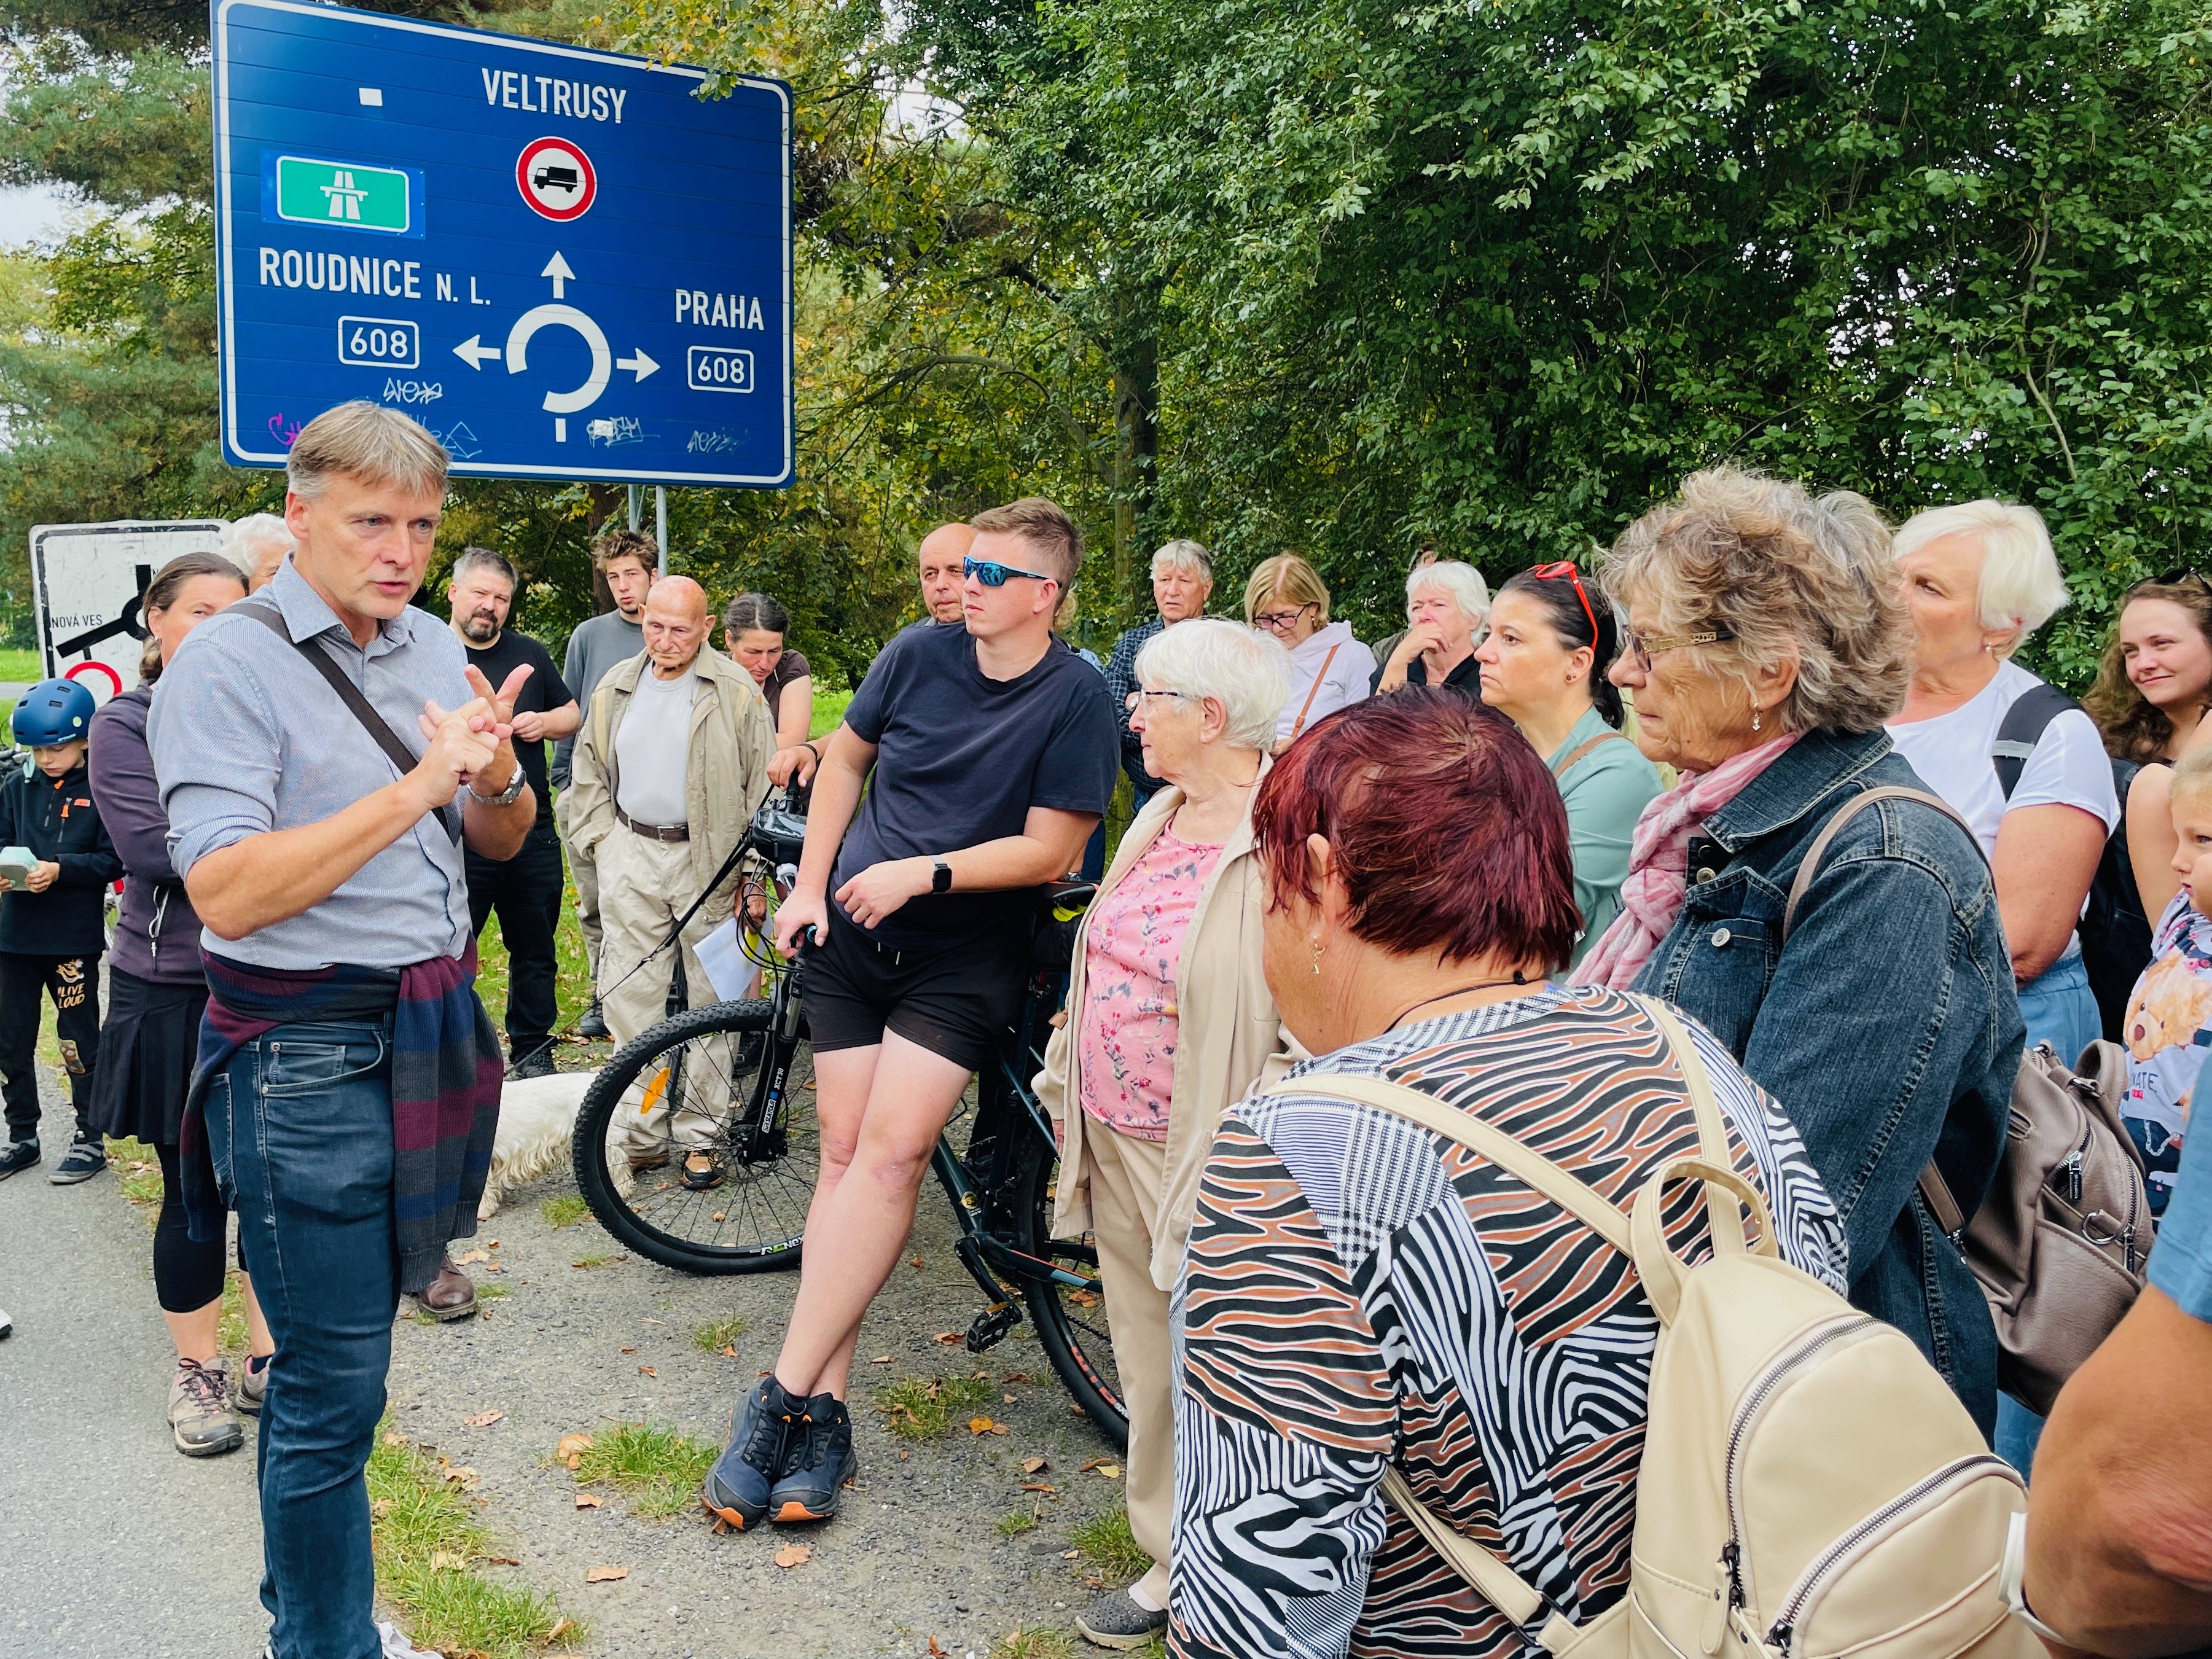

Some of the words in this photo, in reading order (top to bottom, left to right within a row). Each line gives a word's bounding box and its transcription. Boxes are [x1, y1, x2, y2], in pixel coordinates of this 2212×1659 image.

[481, 67, 627, 124] VELTRUSY
[259, 246, 421, 299] ROUDNICE
[436, 273, 459, 303] N.
[470, 276, 491, 306] L.
[675, 289, 765, 330] PRAHA
[350, 327, 408, 359] 608
[697, 356, 745, 384] 608
[82, 614, 103, 626] VES
[58, 994, 85, 1009] LOUD
